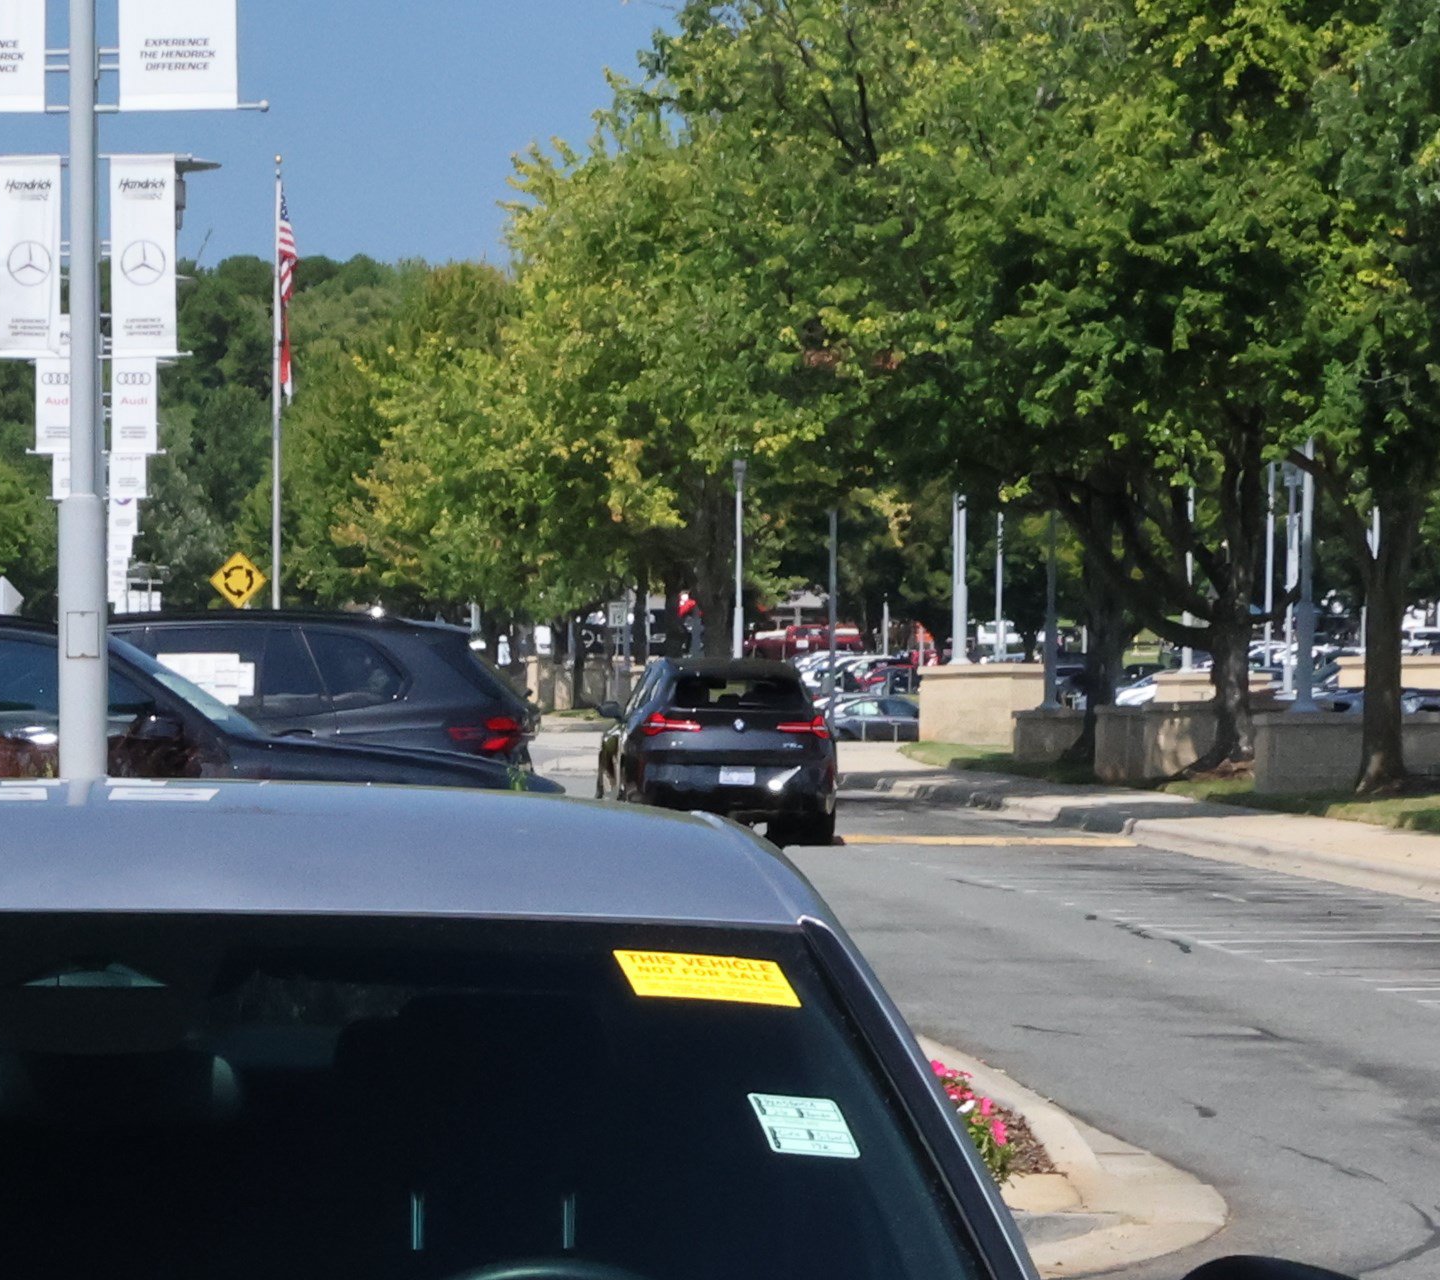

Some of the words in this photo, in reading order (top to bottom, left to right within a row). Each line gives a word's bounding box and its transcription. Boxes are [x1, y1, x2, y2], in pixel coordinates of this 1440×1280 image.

[144, 37, 210, 48] EXPERIENCE
[139, 50, 158, 60] THE
[160, 49, 216, 59] HENDRICK
[145, 61, 210, 71] DIFFERENCE
[5, 178, 52, 193] Hendrick
[119, 177, 166, 193] Hendrick
[45, 397, 70, 406] Aud
[120, 396, 148, 406] Audi
[625, 953, 676, 967] THIS
[681, 956, 775, 974] VEHICLE
[637, 965, 674, 976] NOT
[682, 967, 719, 978] FOR
[727, 970, 773, 982] SALE
